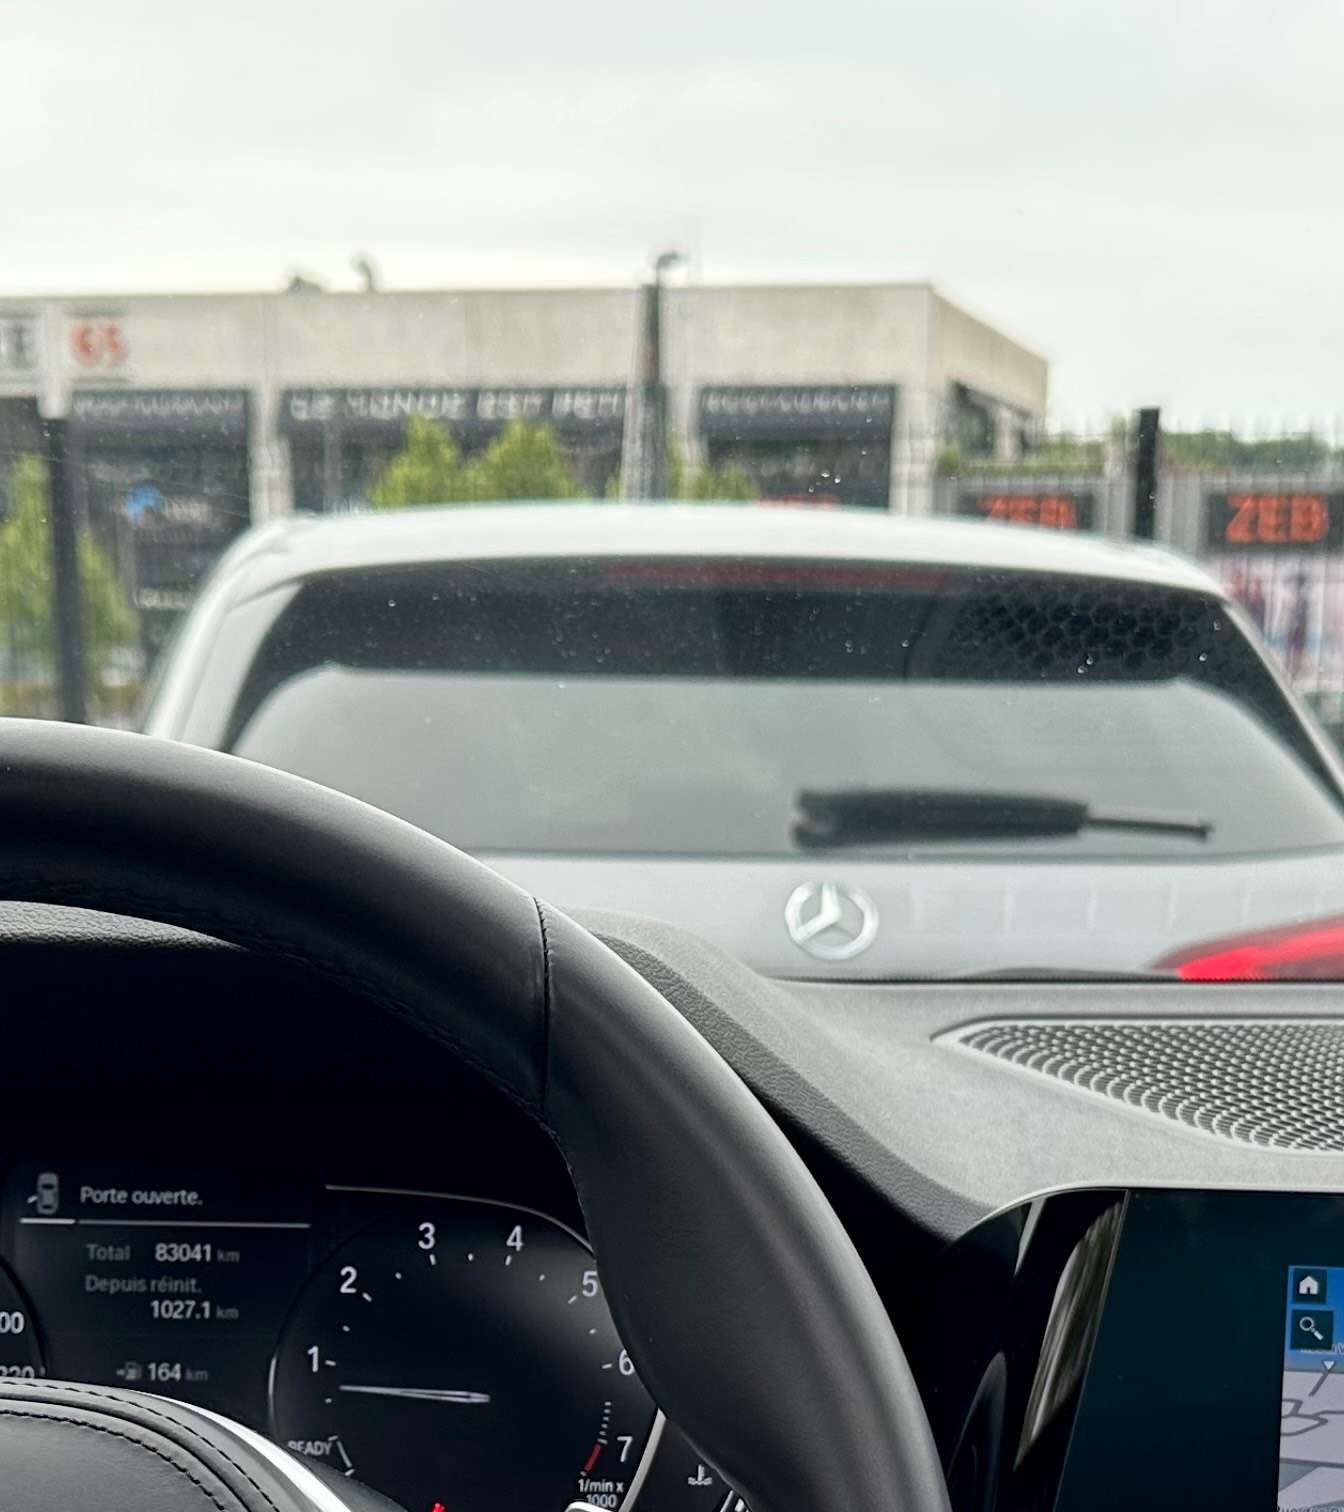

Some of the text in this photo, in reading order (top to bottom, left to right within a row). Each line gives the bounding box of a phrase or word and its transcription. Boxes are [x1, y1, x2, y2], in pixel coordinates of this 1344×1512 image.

[80, 1186, 203, 1206] Porte ouverte.
[418, 1222, 435, 1249] 3
[506, 1225, 523, 1251] 4
[86, 1243, 240, 1262] Total 83041 km
[85, 1275, 202, 1294] Depuis réinit.
[339, 1266, 357, 1294] 2
[582, 1270, 598, 1297] 5
[151, 1301, 239, 1319] 1027.1 km
[307, 1346, 320, 1372] 1
[618, 1349, 635, 1375] 6
[148, 1363, 208, 1381] 164 km
[287, 1440, 333, 1456] READY
[617, 1436, 633, 1462] 7
[578, 1478, 612, 1494] 1/min
[586, 1494, 617, 1507] 1000
